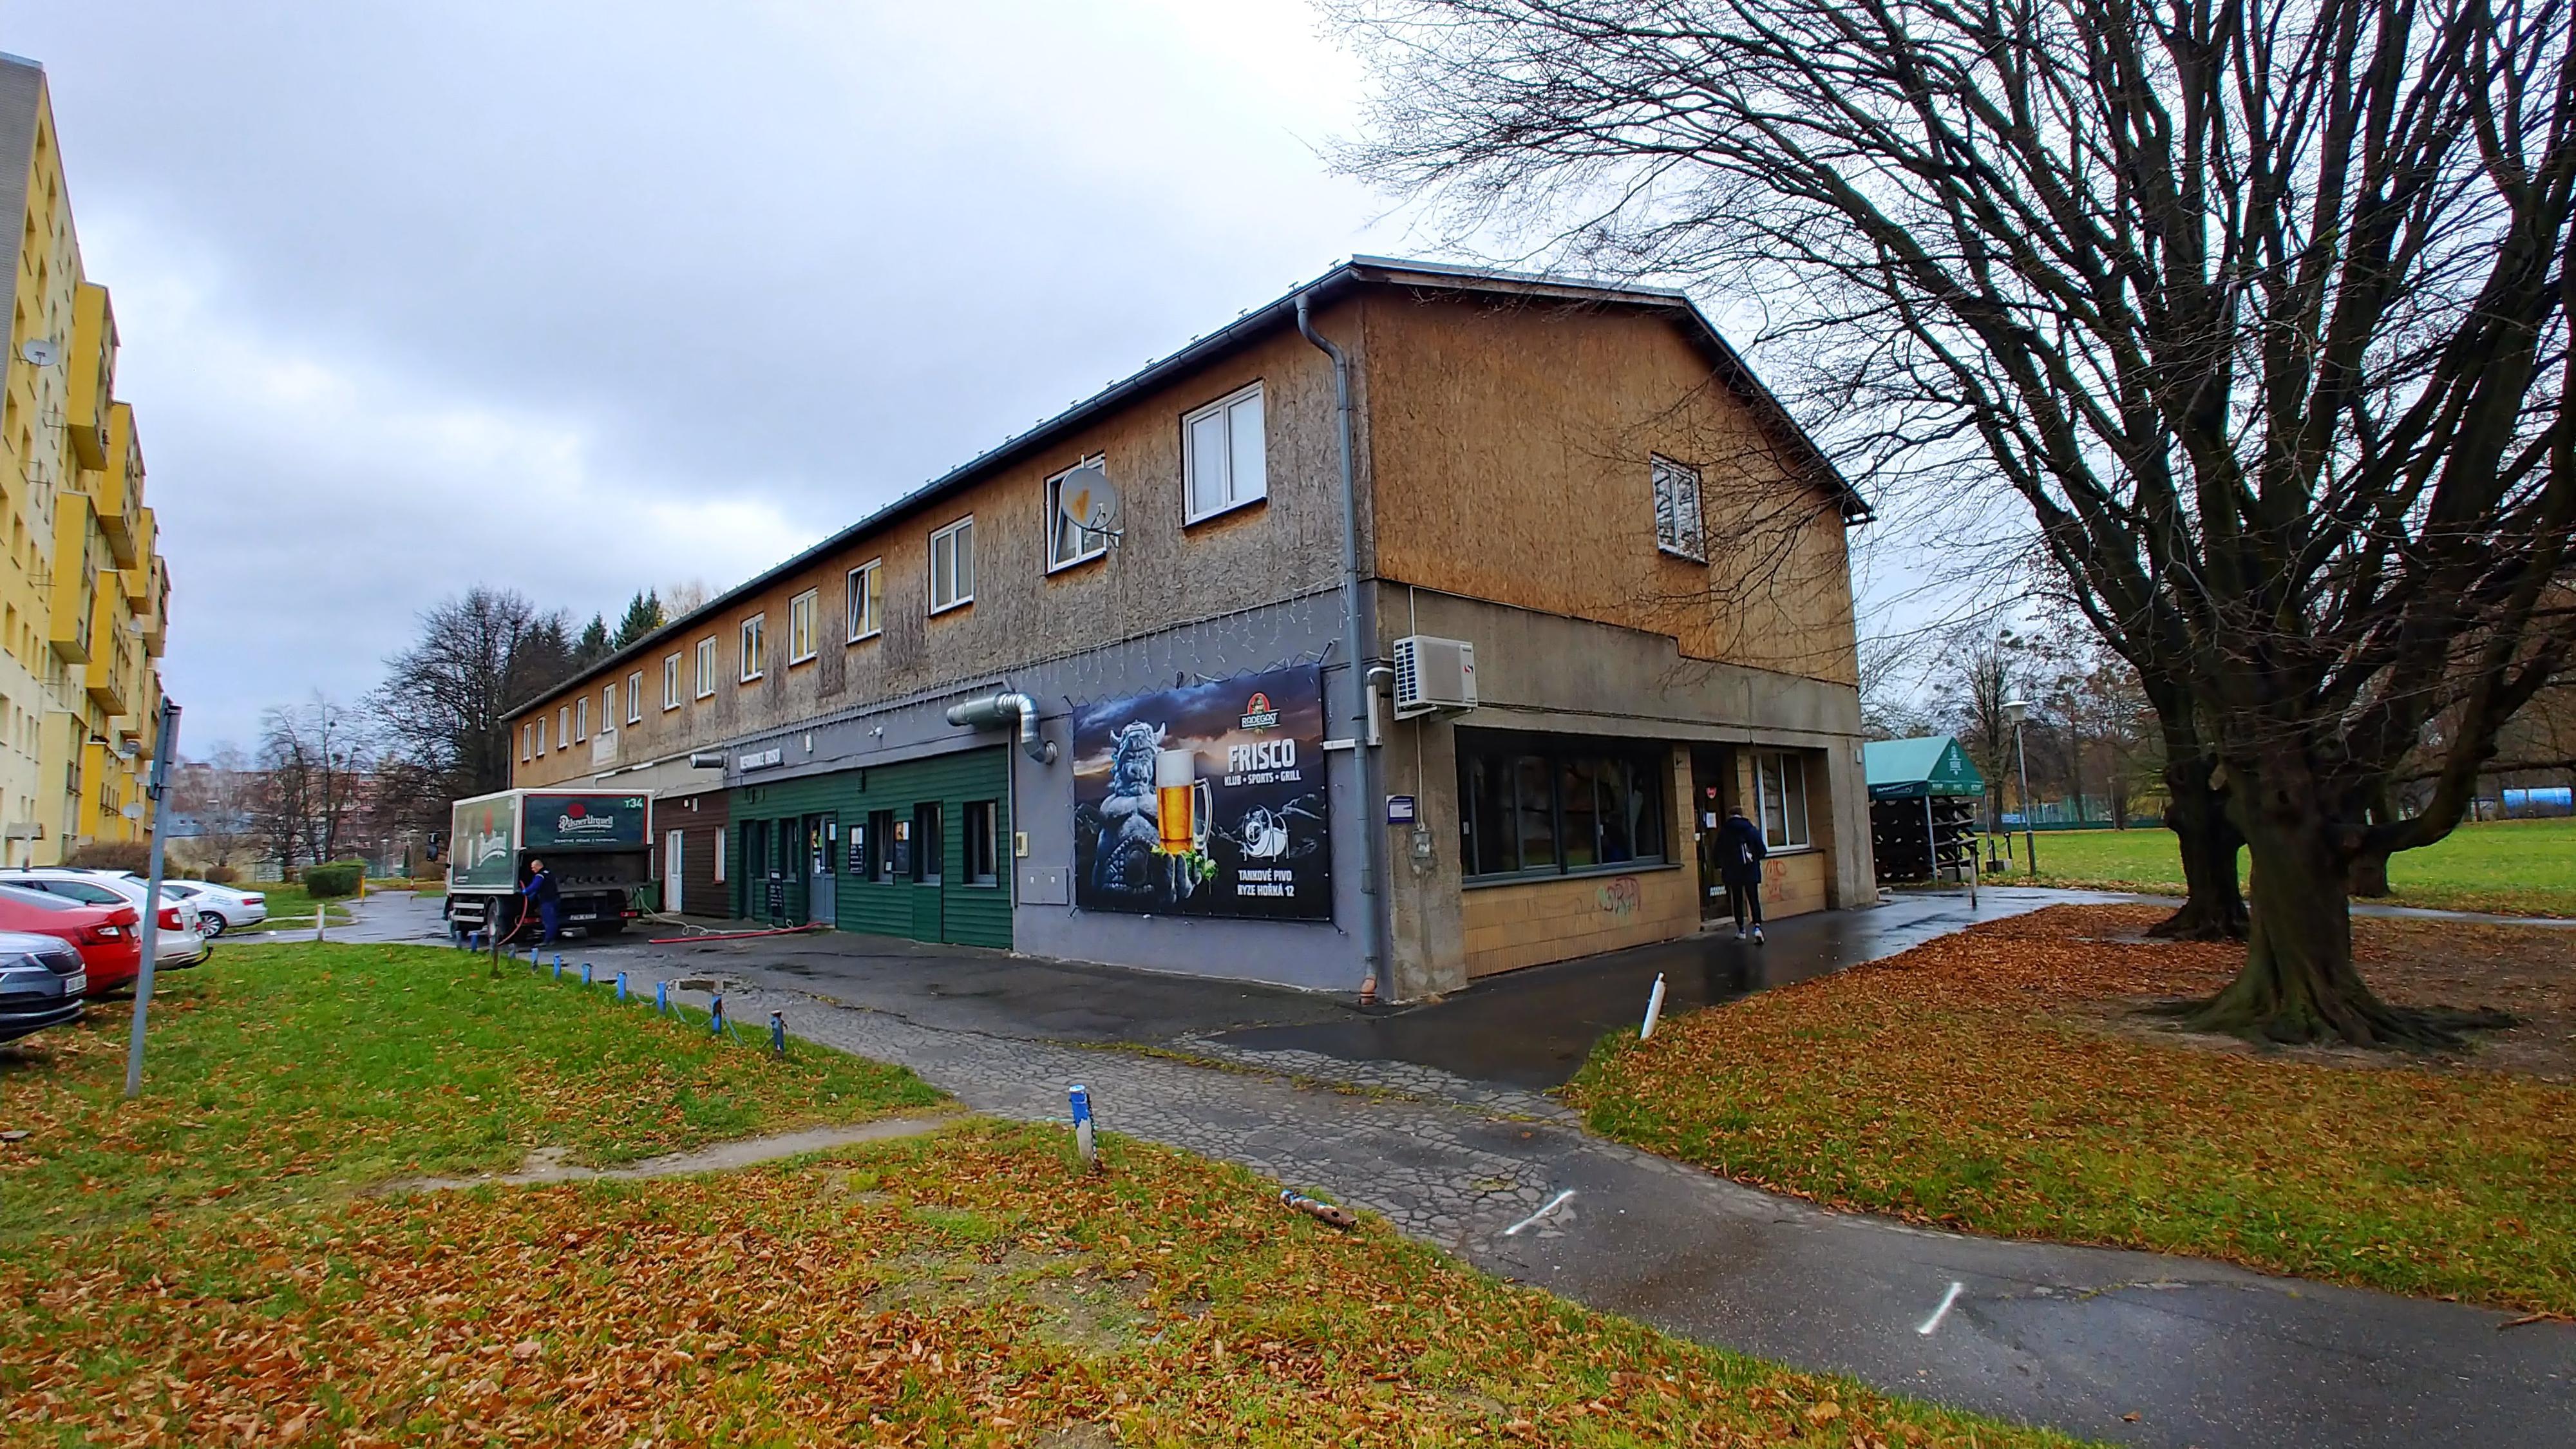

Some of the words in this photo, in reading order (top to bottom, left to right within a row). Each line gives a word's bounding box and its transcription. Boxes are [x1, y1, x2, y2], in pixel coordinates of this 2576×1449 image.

[1242, 713, 1278, 727] RADEGAST
[1228, 739, 1296, 772] FRISCO
[1224, 775, 1241, 786] KLUB
[1247, 773, 1274, 784] SPORTS
[1280, 770, 1301, 781] GRILL
[624, 799, 643, 808] T34
[558, 815, 587, 833] Pilsner
[587, 814, 613, 828] Urquell
[1238, 868, 1272, 882] TANKOVÉ
[1274, 870, 1292, 882] PIVO
[1257, 883, 1284, 896] HOŘKÁ
[1285, 886, 1294, 896] 12
